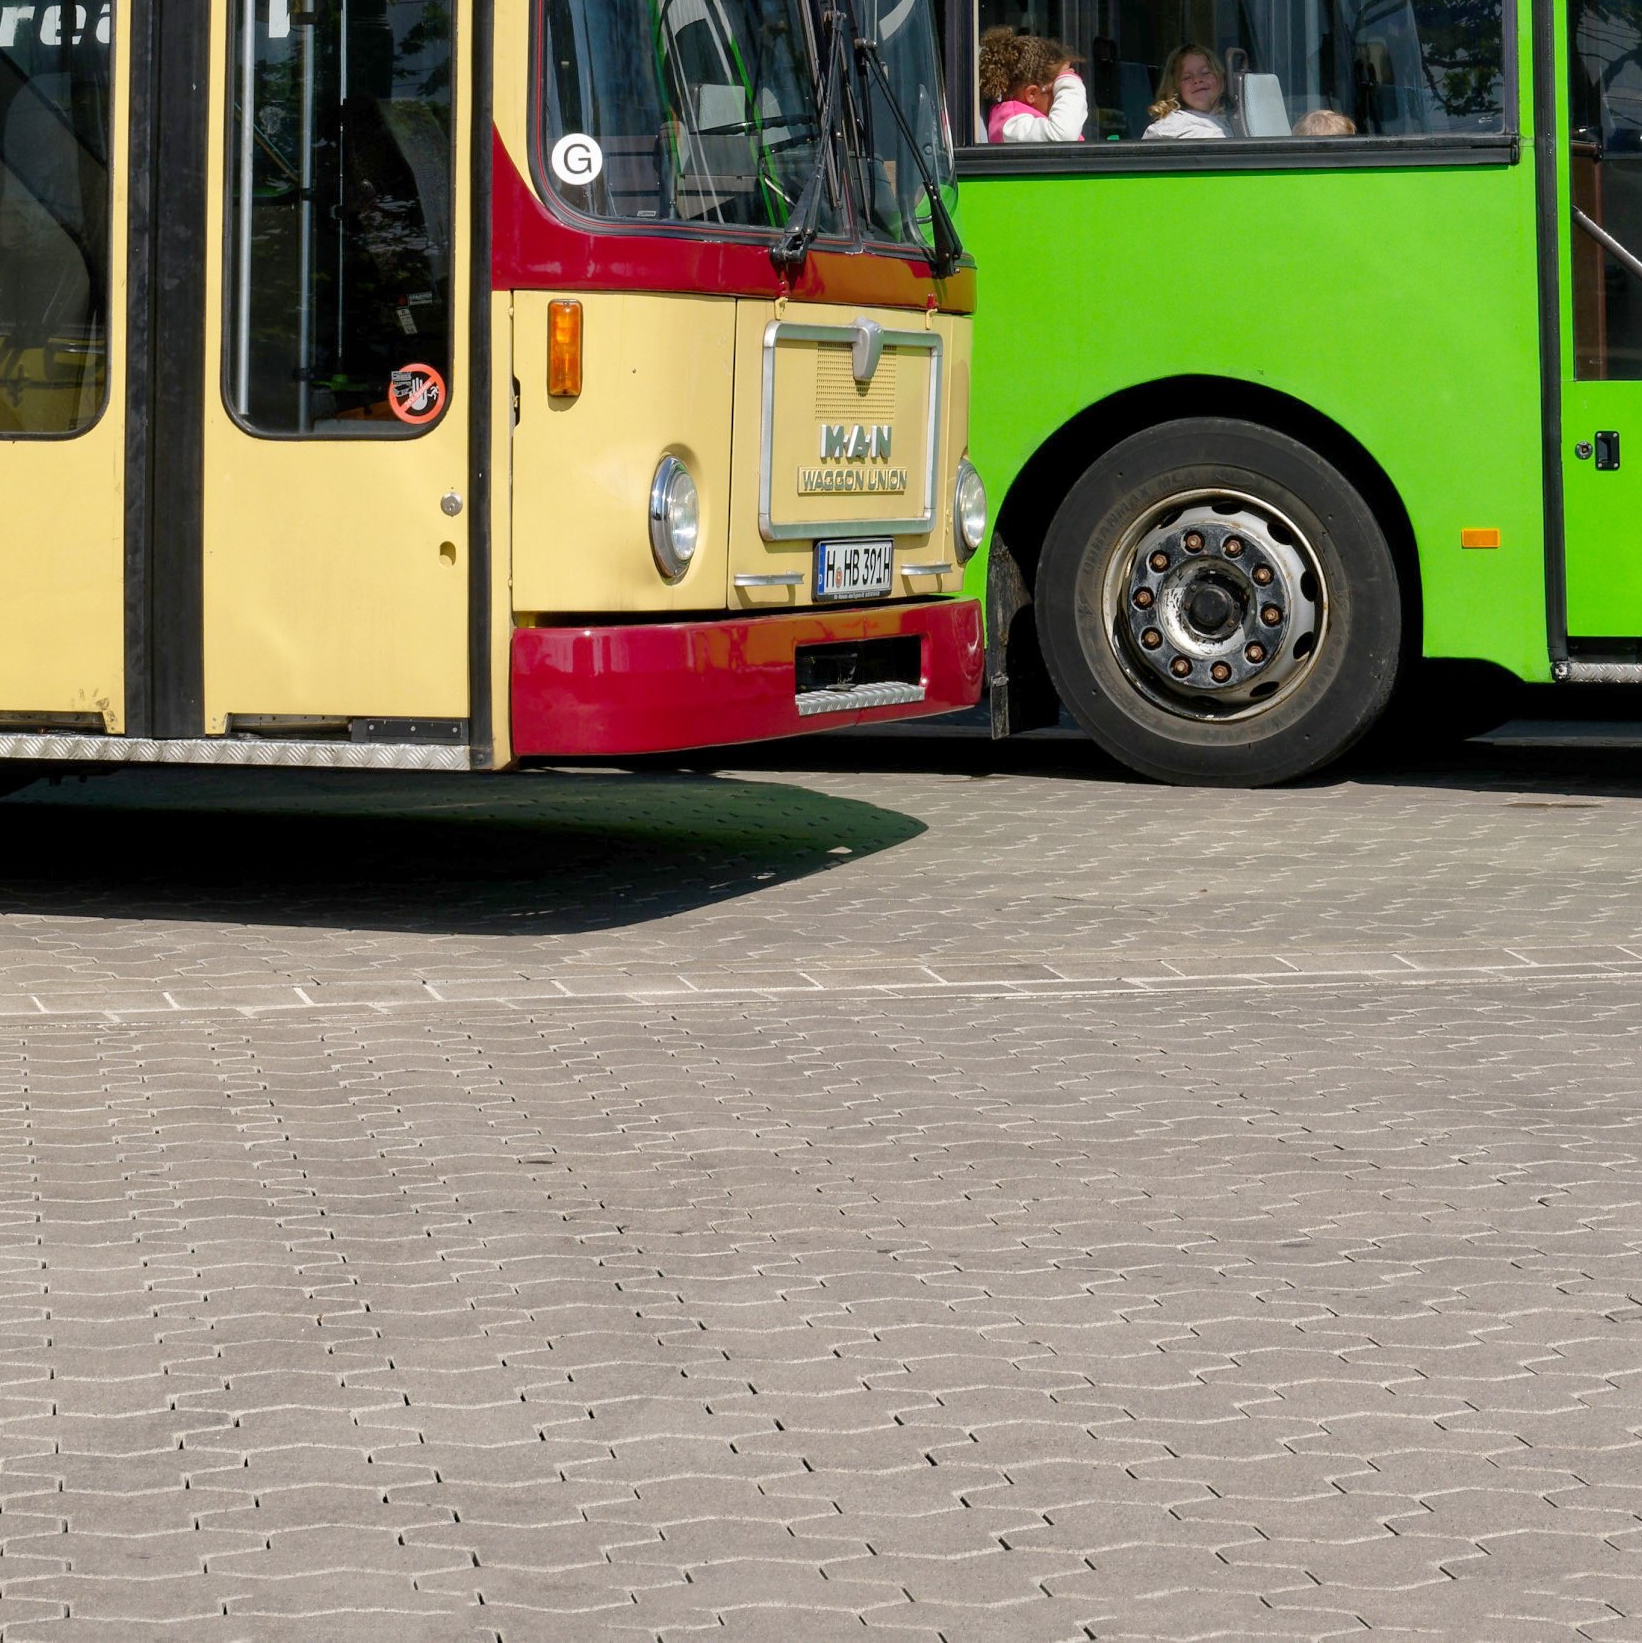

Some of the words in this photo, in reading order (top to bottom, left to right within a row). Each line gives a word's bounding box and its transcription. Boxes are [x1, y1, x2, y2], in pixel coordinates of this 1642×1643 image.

[563, 143, 592, 174] G
[803, 468, 865, 491] WAGGON
[868, 468, 908, 490] UNION
[826, 550, 836, 588] H
[843, 548, 860, 587] HB
[862, 545, 891, 585] 391H
